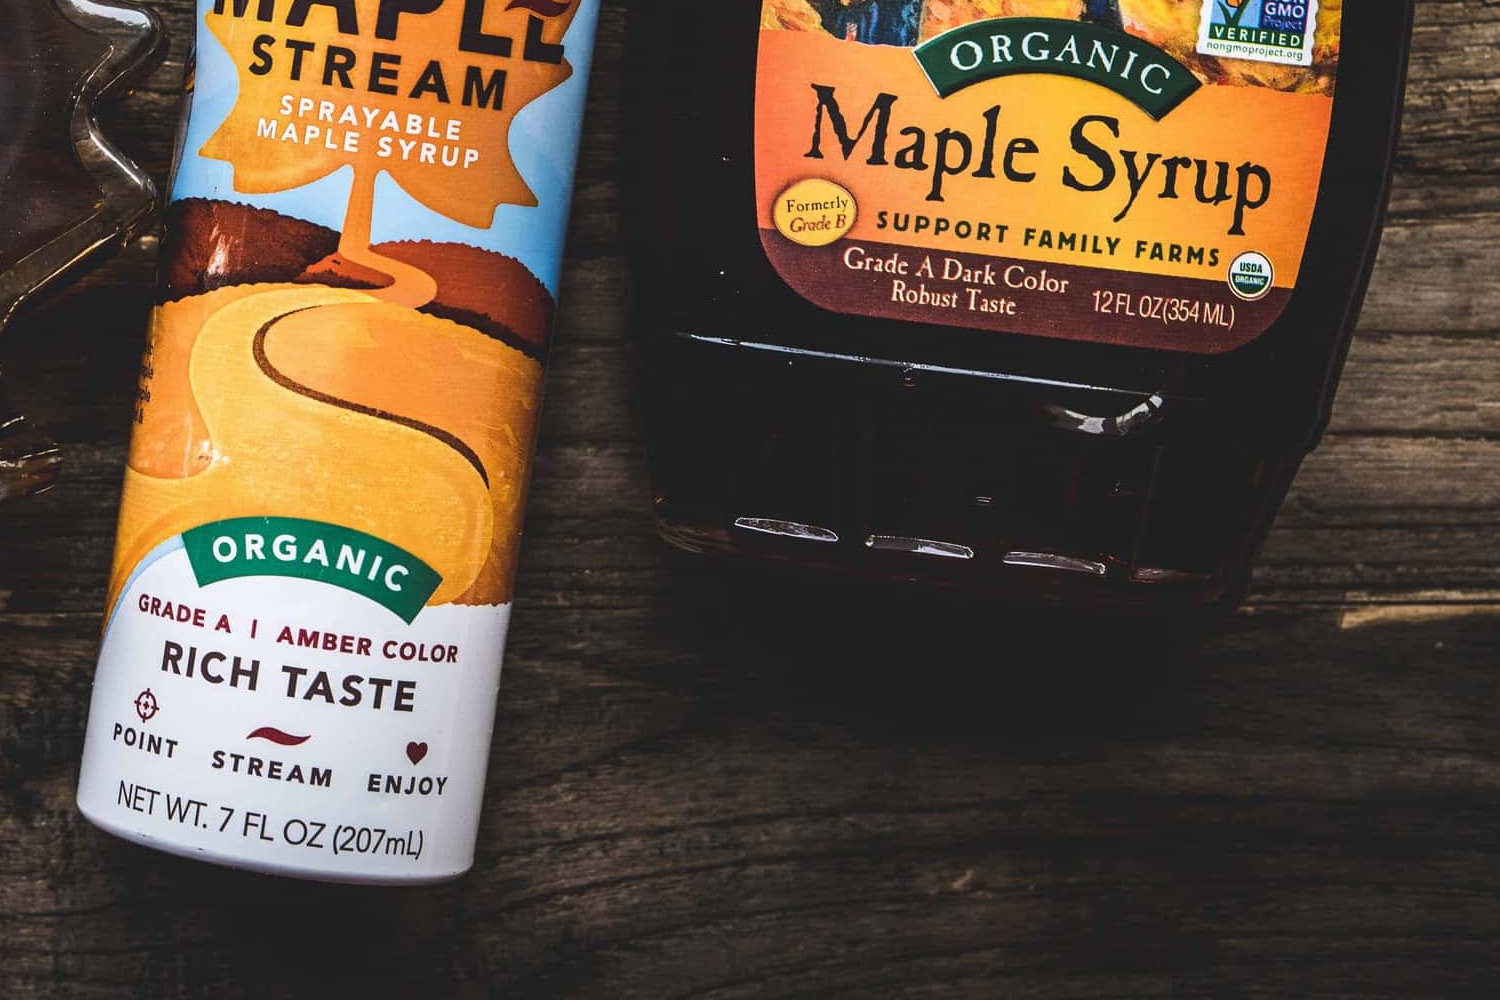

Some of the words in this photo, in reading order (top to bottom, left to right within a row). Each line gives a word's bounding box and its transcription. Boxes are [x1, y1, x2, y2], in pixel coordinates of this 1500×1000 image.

[1264, 2, 1304, 18] GMO
[1206, 41, 1303, 61] nongmoproject.org
[1213, 25, 1300, 47] VERIFIED
[246, 33, 507, 111] STREAM
[950, 32, 1171, 96] ORGANIC
[278, 94, 462, 141] SPRAYABLE
[256, 117, 360, 152] MAPLE
[376, 135, 480, 169] SYRUP
[798, 82, 1039, 203] Maple
[1061, 114, 1272, 236] Syrup
[786, 196, 848, 213] Formerly
[790, 215, 832, 233] Grade
[835, 213, 847, 229] B
[876, 210, 1009, 243] SUPPORT
[1023, 227, 1121, 256] FAMILY
[1134, 239, 1219, 267] FARMS
[843, 246, 909, 275] Grade
[915, 255, 934, 278] A
[942, 257, 996, 285] Dark
[1003, 265, 1069, 293] Color
[1239, 261, 1264, 274] USDA
[891, 279, 958, 308] Robust
[967, 288, 1016, 315] Taste
[212, 533, 410, 593] ORGANIC
[138, 593, 206, 628] GRADE
[214, 613, 231, 634] A
[275, 625, 372, 656] AMBER
[382, 639, 458, 663] COLOR
[160, 639, 260, 691] RICH
[281, 664, 417, 712] TASTE
[112, 722, 178, 758] POINT
[211, 749, 332, 788] STREAM
[367, 773, 448, 795] ENJOY
[117, 779, 161, 815] NET
[165, 793, 208, 829] WT.
[218, 806, 234, 832] 7
[242, 811, 274, 842] FL
[282, 818, 326, 849] OZ
[332, 824, 423, 861] (207mL)
